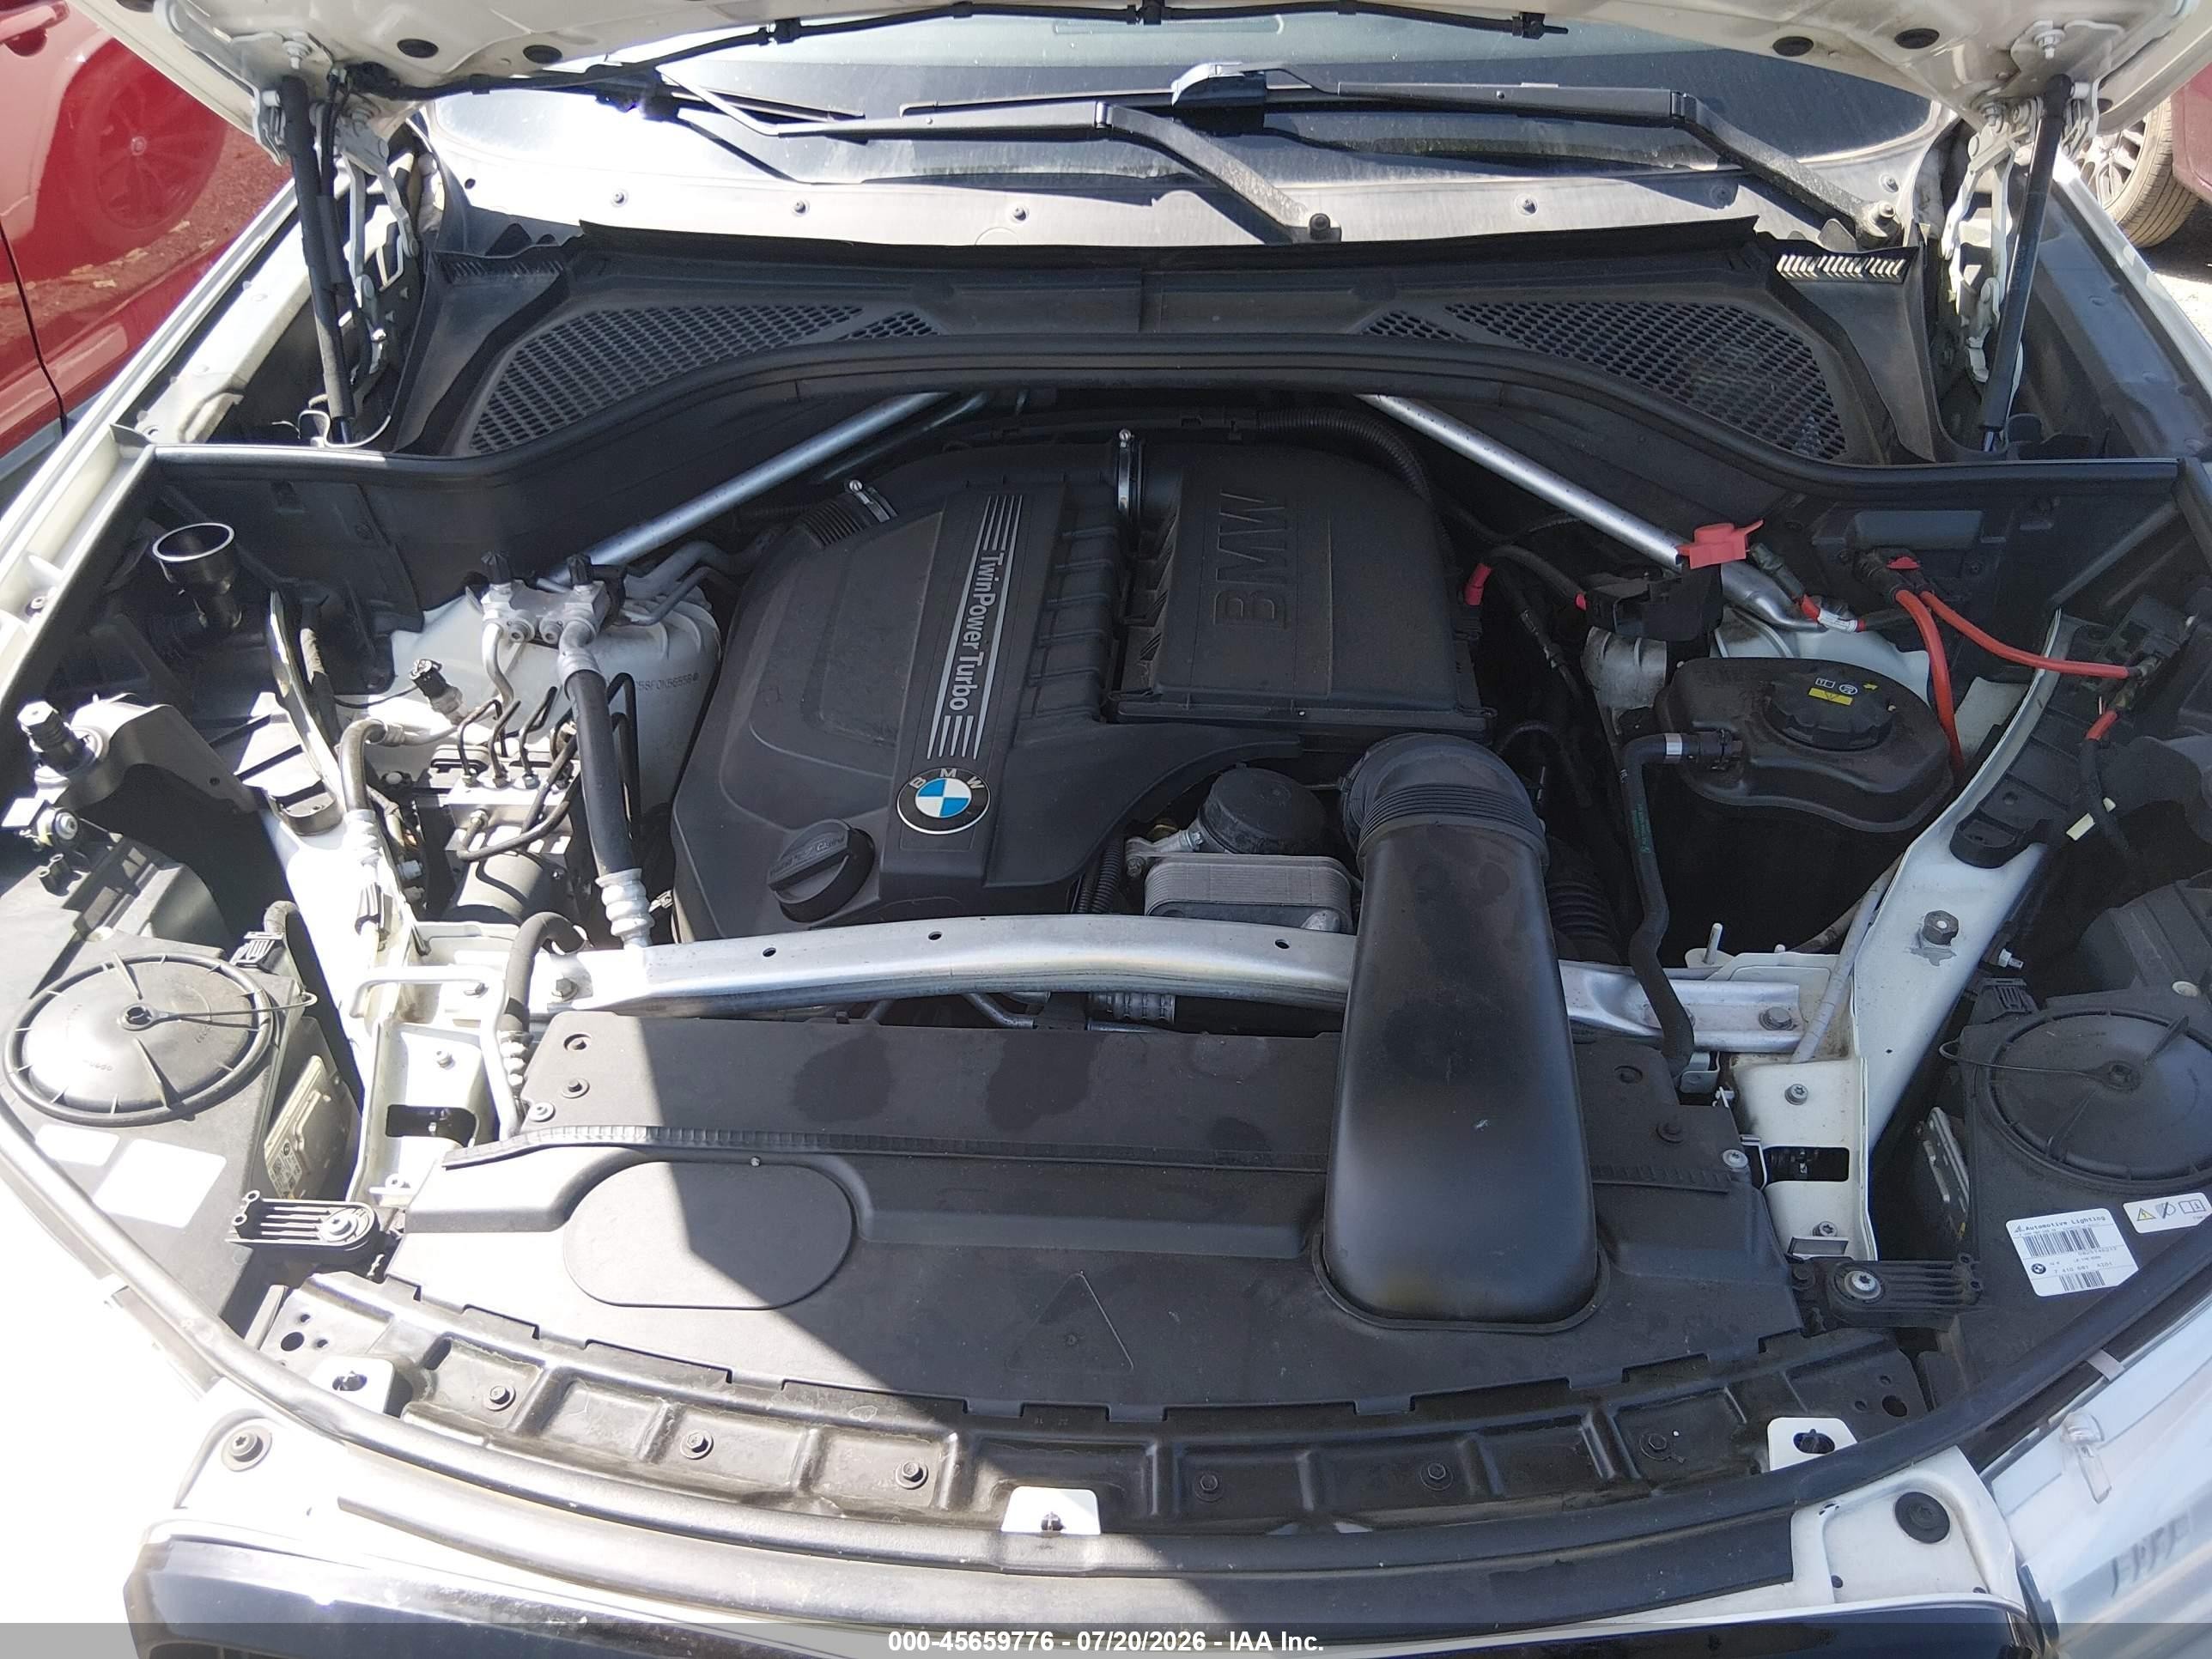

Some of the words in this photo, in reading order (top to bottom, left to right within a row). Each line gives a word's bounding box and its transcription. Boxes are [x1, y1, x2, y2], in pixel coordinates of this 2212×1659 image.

[1212, 489, 1287, 630] BMW
[962, 552, 1005, 649] TwinPower
[949, 651, 985, 711] Turbo
[908, 768, 985, 789] BMW
[2026, 1221, 2068, 1231] Automotive
[2071, 1215, 2106, 1226] Lighting
